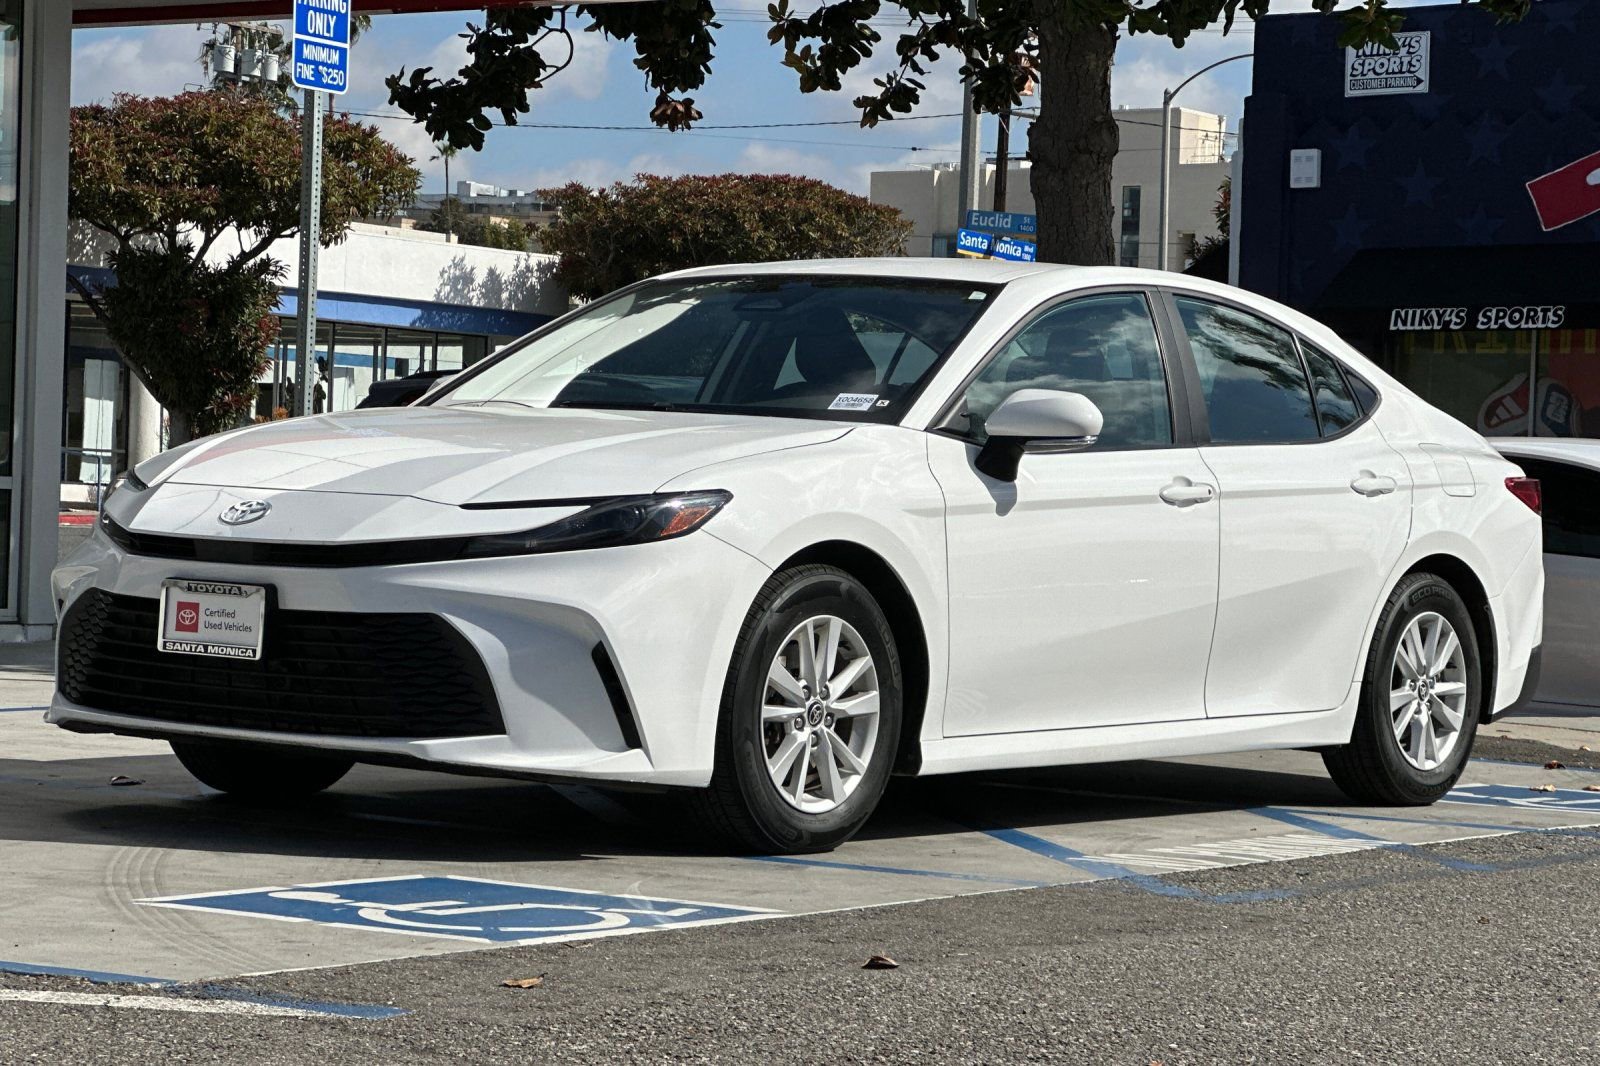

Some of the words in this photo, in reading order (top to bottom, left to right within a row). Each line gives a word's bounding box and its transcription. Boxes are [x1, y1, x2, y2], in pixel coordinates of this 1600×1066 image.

[307, 10, 336, 37] ONLY
[303, 43, 339, 65] MINIMUM
[296, 62, 315, 80] FINE
[322, 66, 344, 86] $250
[1350, 55, 1422, 77] SPORTS
[1350, 78, 1386, 90] CUSTOMER
[1387, 76, 1417, 88] PARKING
[971, 212, 1012, 228] Euclid
[1023, 216, 1030, 224] St
[960, 232, 988, 250] Santa
[1389, 308, 1467, 331] NIKY'S
[1476, 306, 1566, 329] SPORTS
[189, 583, 240, 595] TOYOTA
[1412, 586, 1431, 601] ECO
[204, 608, 236, 619] Certified
[204, 622, 222, 630] Used
[223, 622, 252, 632] Vehicles
[165, 642, 205, 653] SANTA
[207, 645, 254, 657] MONICA
